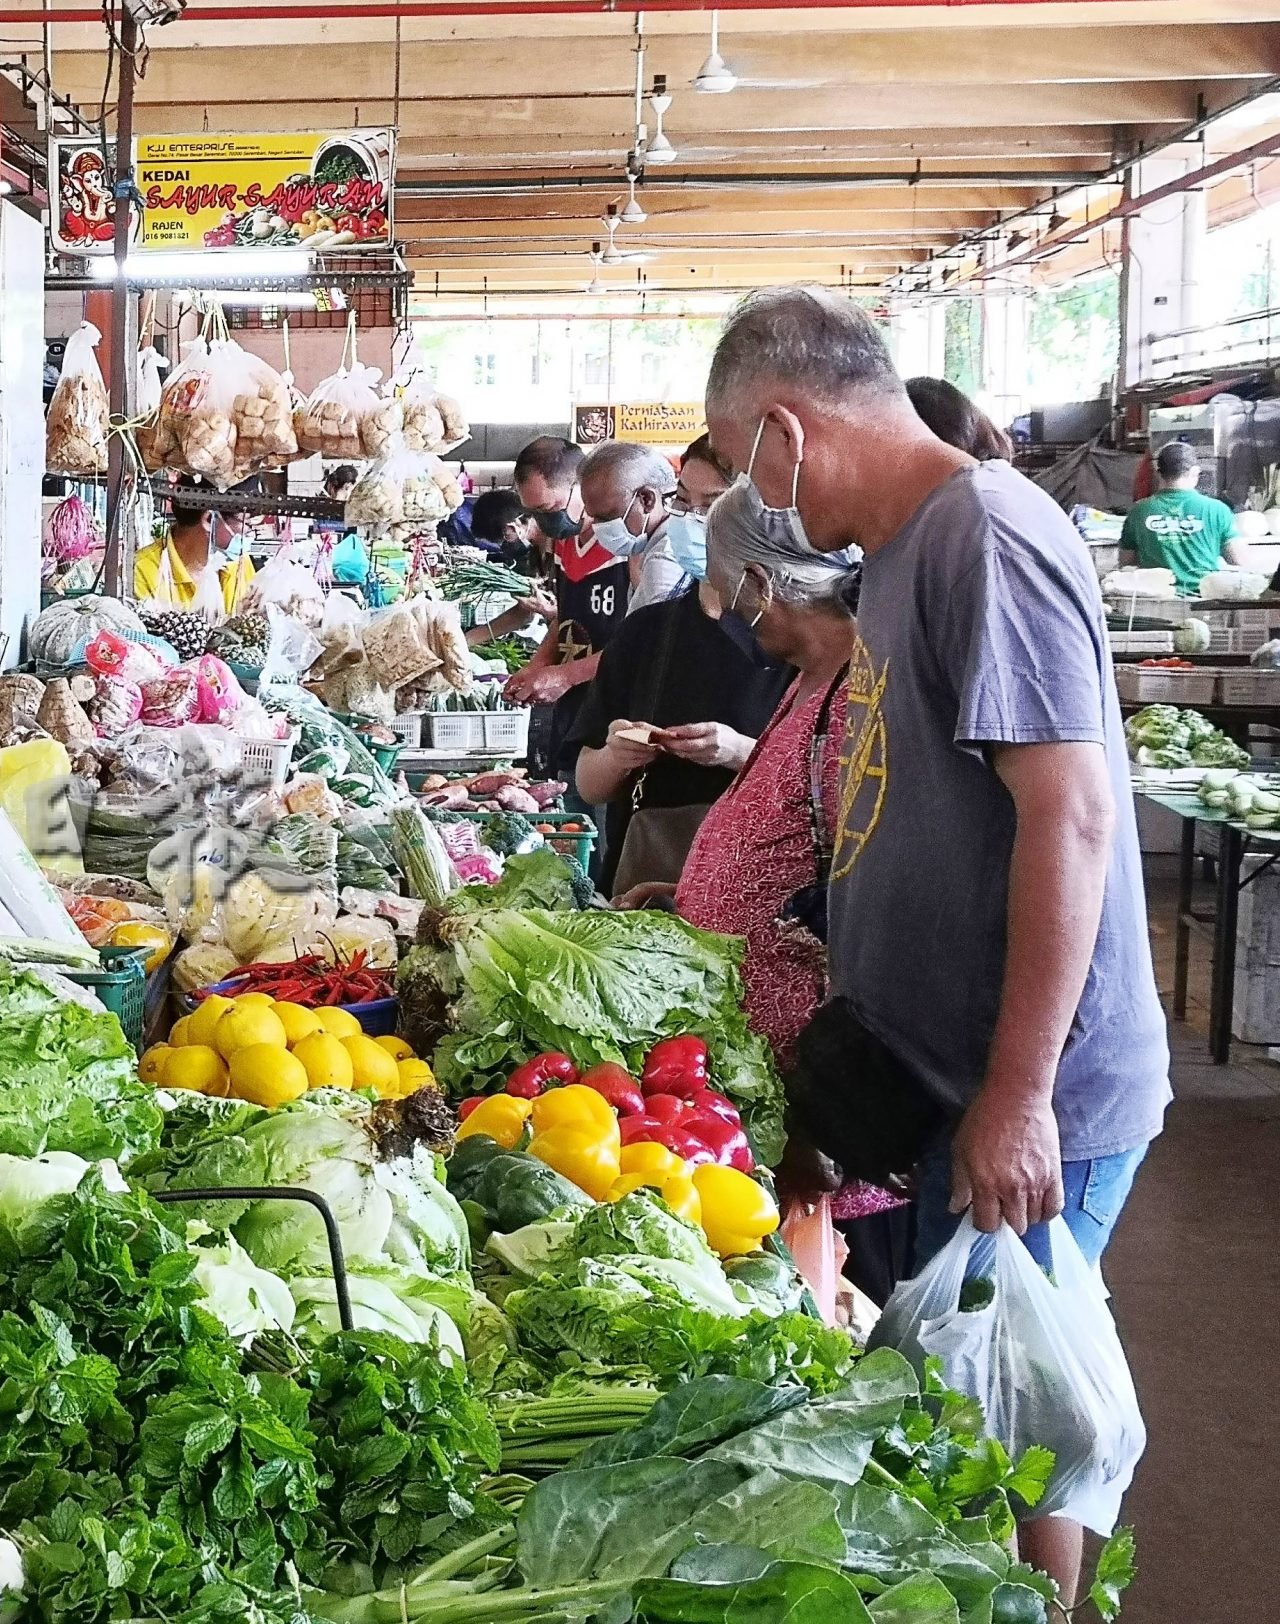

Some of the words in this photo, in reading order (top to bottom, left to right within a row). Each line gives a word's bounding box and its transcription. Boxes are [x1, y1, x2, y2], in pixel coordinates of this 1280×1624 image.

[169, 142, 235, 152] ENTERPRISE
[143, 171, 190, 182] KEDAI
[152, 221, 183, 231] RAJEN
[145, 232, 159, 240] 016
[620, 403, 695, 419] Perniagaan
[621, 417, 696, 430] Kathiravan
[590, 584, 615, 616] 68
